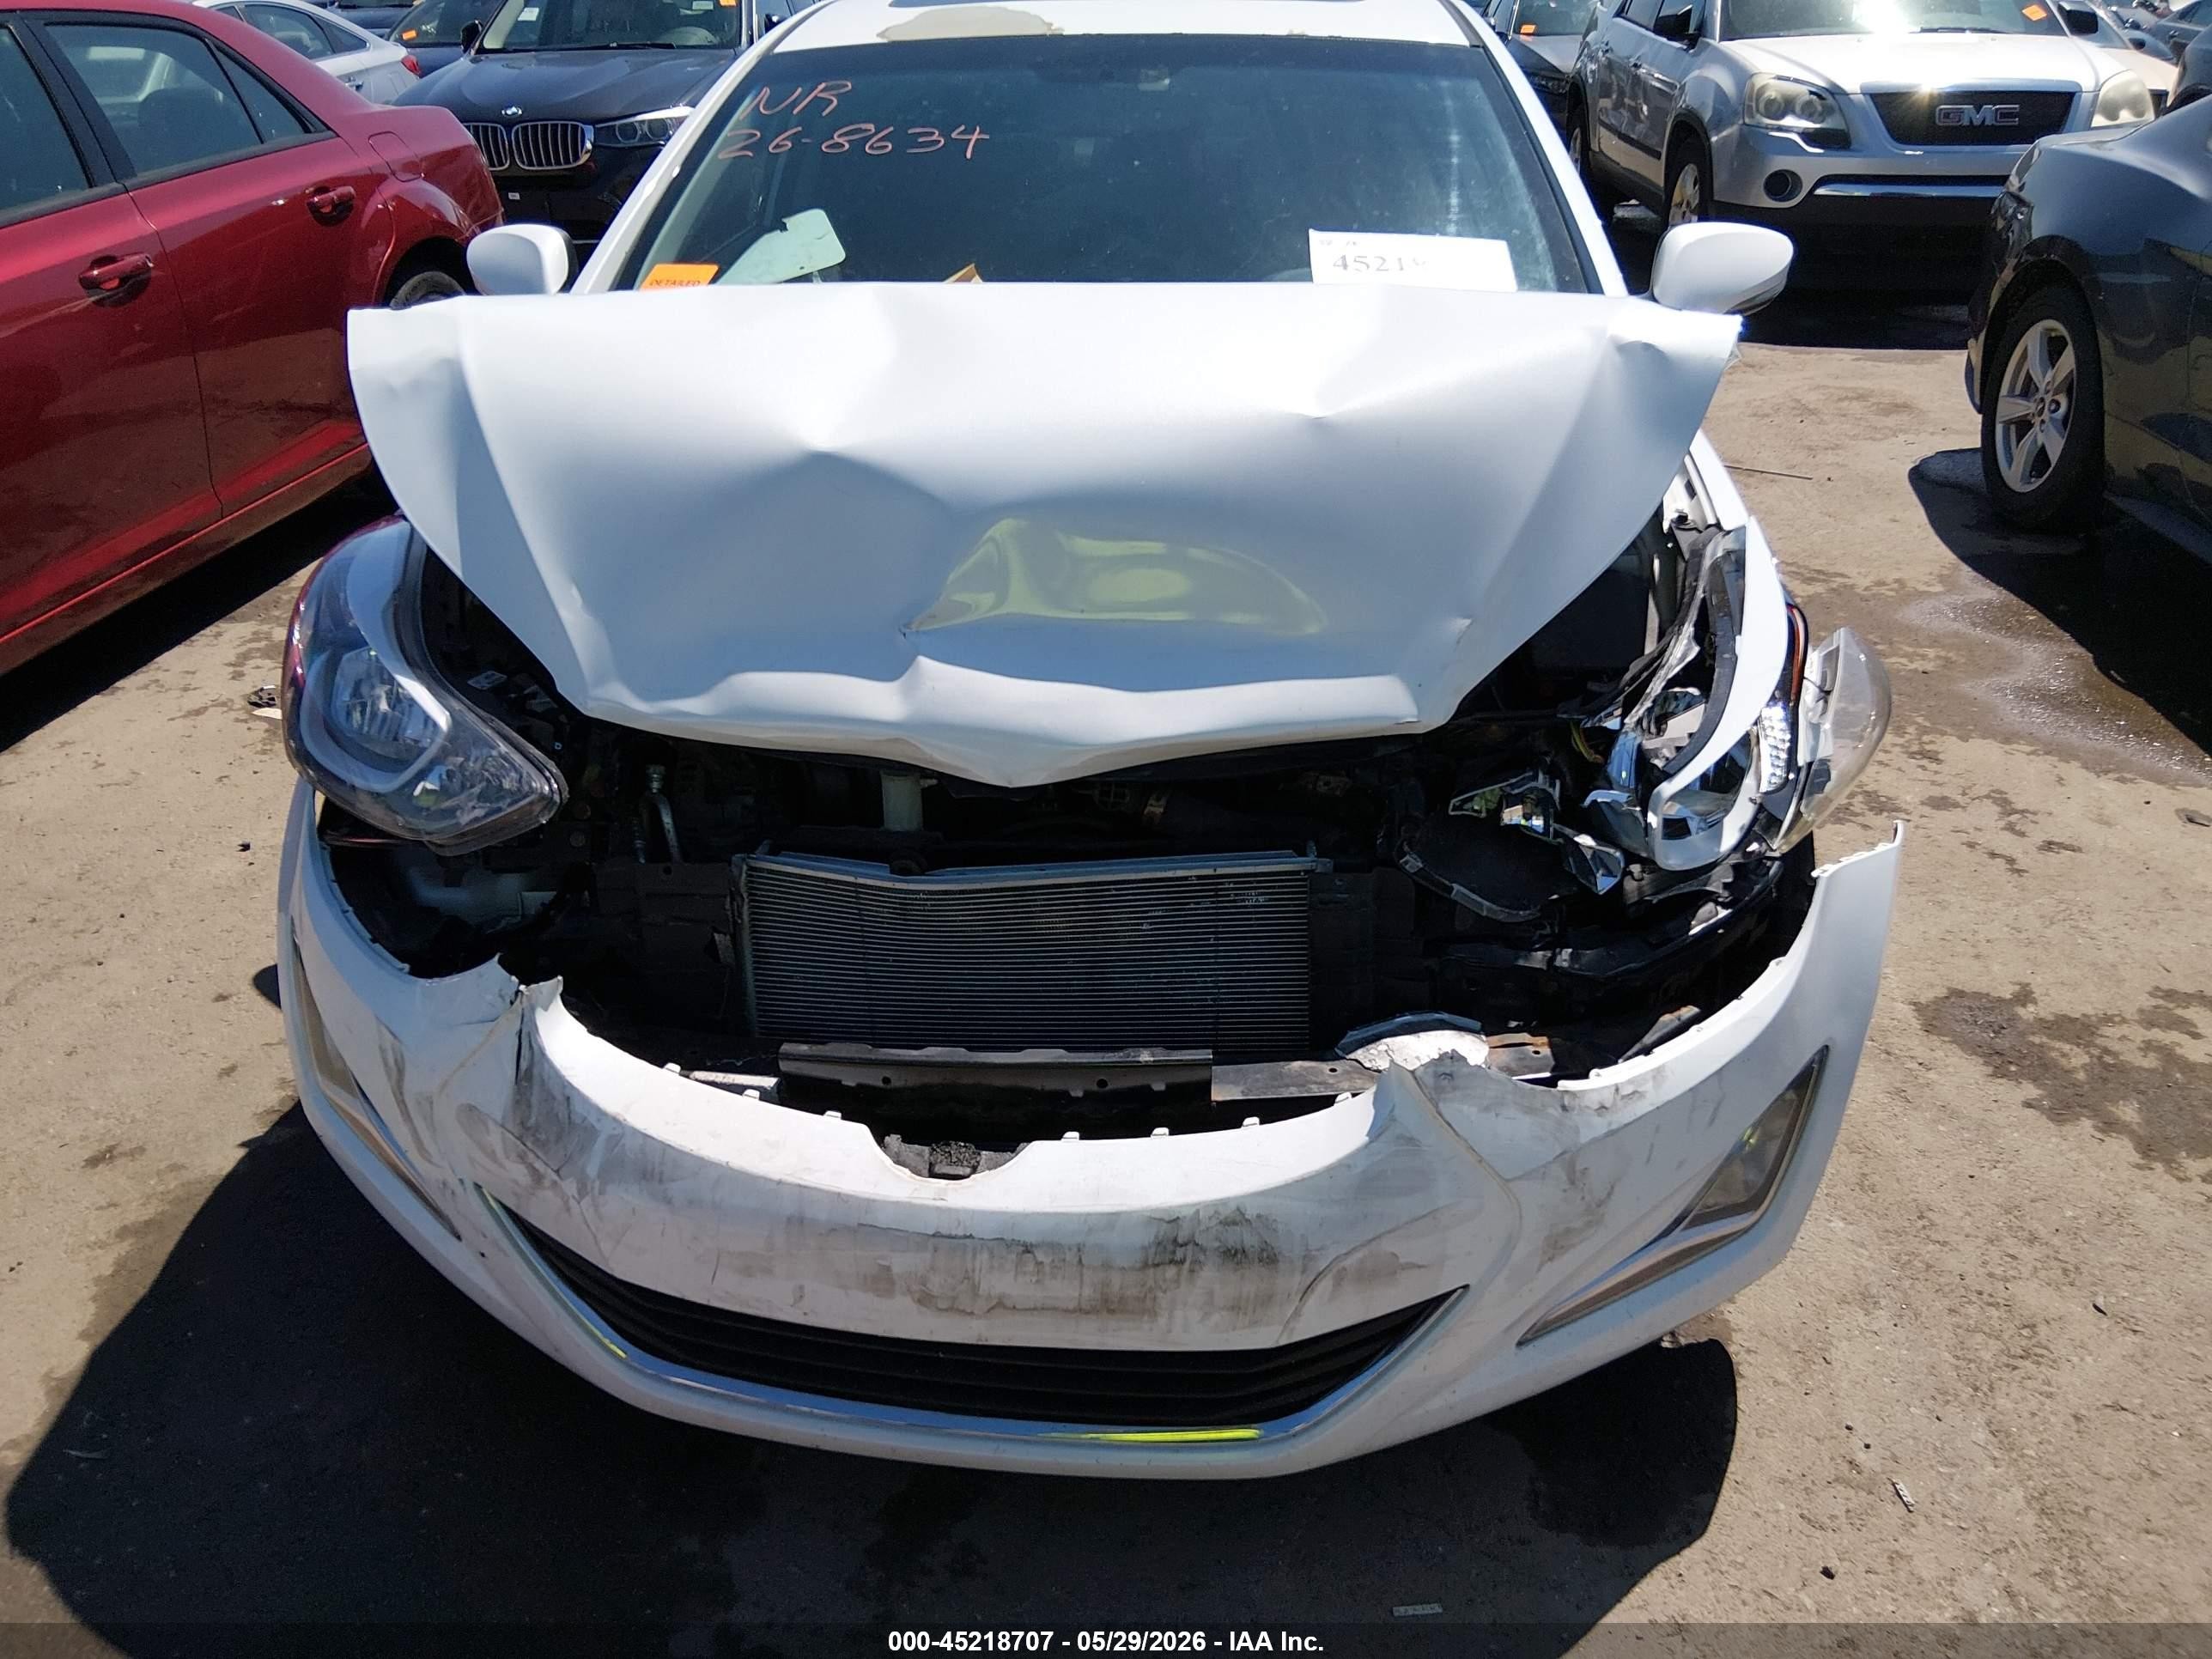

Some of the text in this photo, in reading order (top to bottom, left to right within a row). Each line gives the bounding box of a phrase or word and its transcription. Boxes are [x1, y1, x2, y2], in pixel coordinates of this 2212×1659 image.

[738, 82, 852, 120] NR
[1936, 105, 2020, 125] GMC
[718, 124, 990, 159] 26-8634
